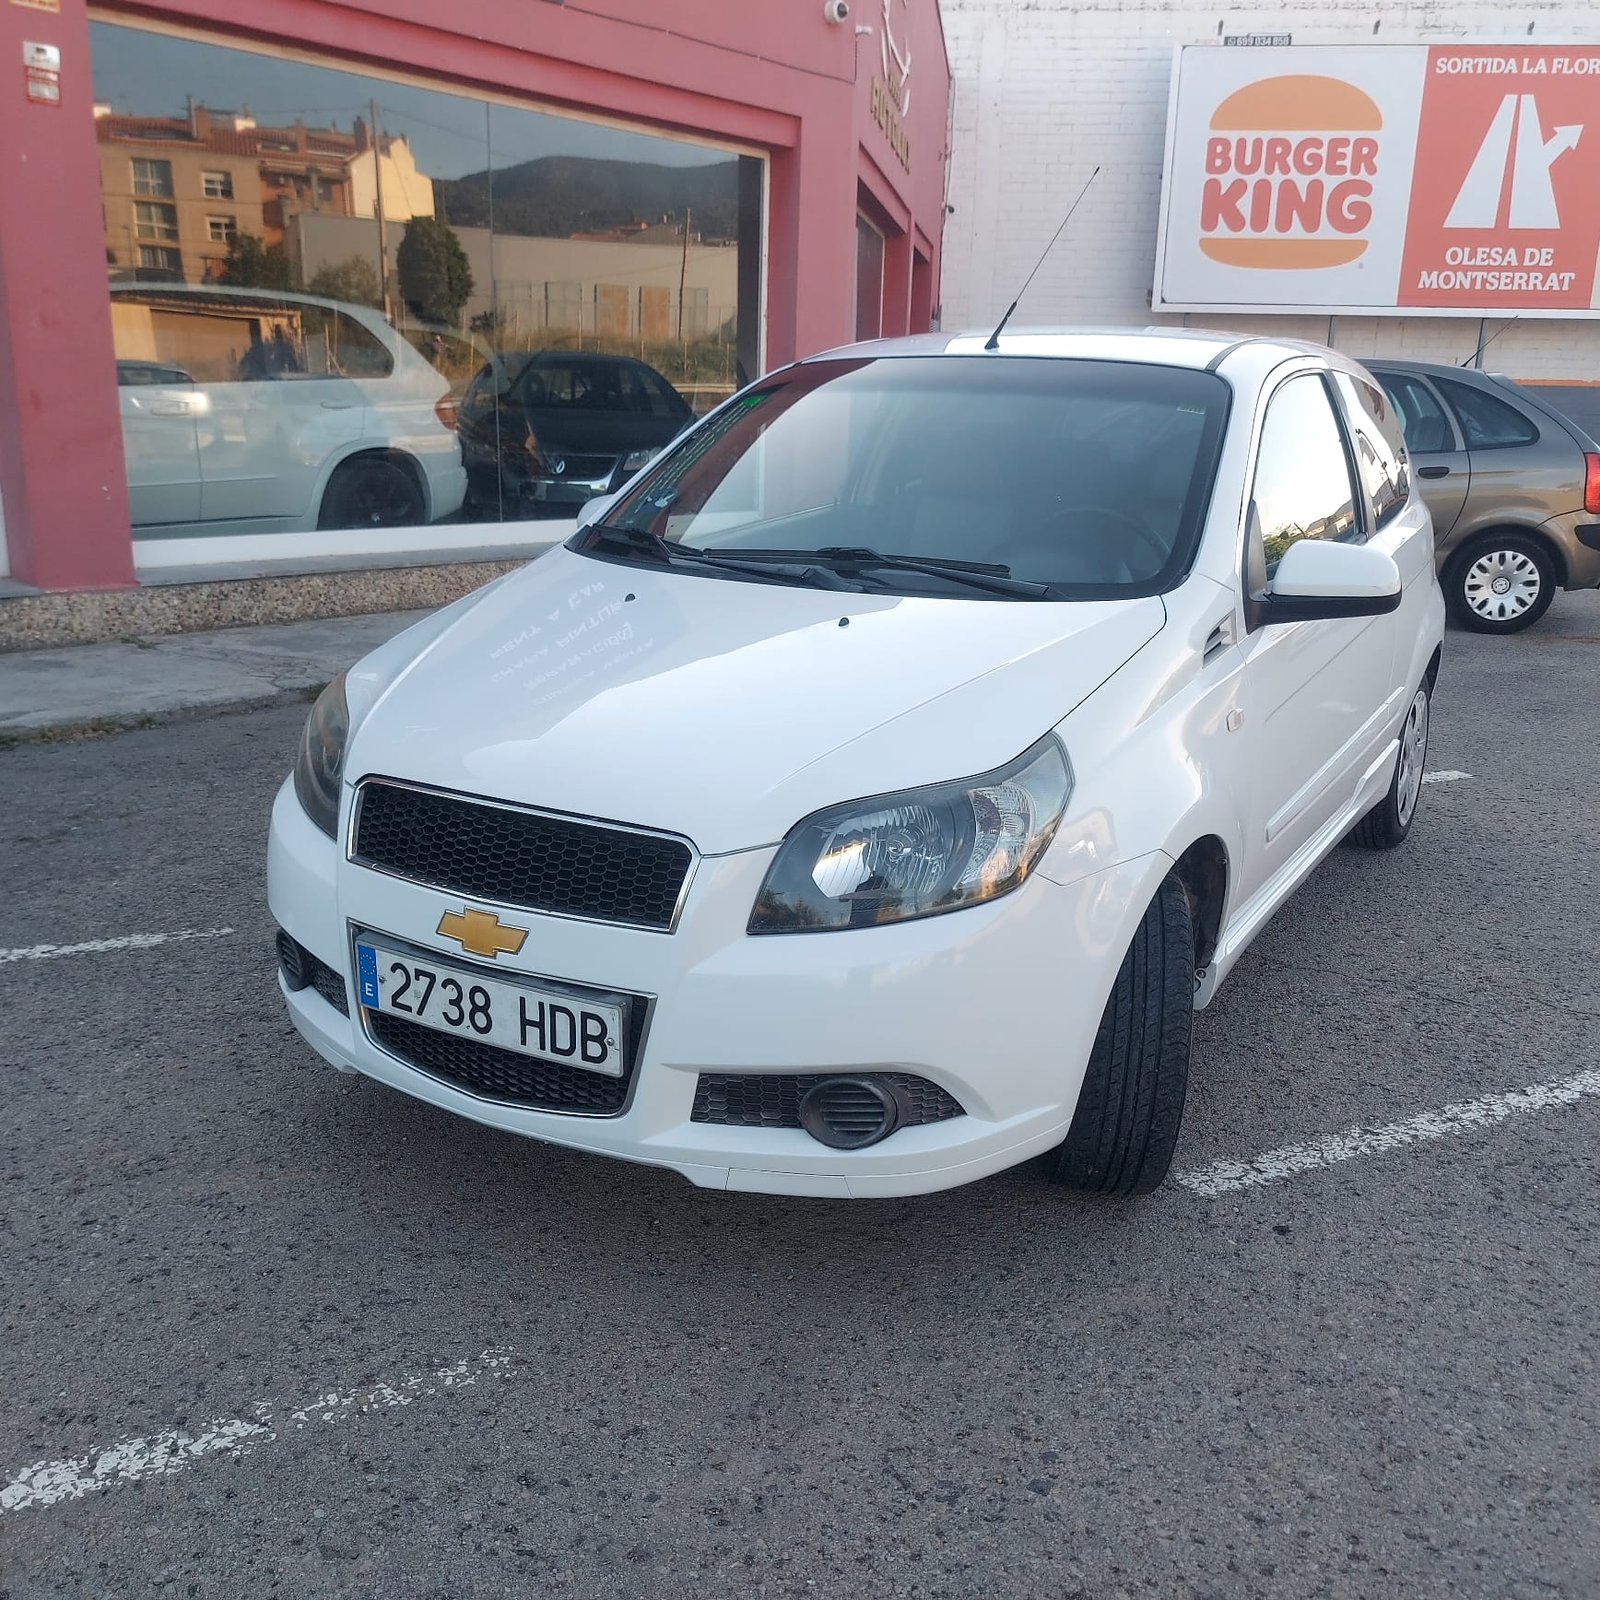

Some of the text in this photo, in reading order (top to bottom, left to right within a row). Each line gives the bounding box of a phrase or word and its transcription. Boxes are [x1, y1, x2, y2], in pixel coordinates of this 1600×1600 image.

[1435, 57, 1600, 75] SORTIDA LA FLOR
[1205, 137, 1379, 176] BURGER
[1200, 178, 1374, 234] KING
[1445, 247, 1554, 267] OLESA DE
[1418, 271, 1575, 291] MONTSERRAT
[364, 962, 608, 1064] E 2738 HDB
